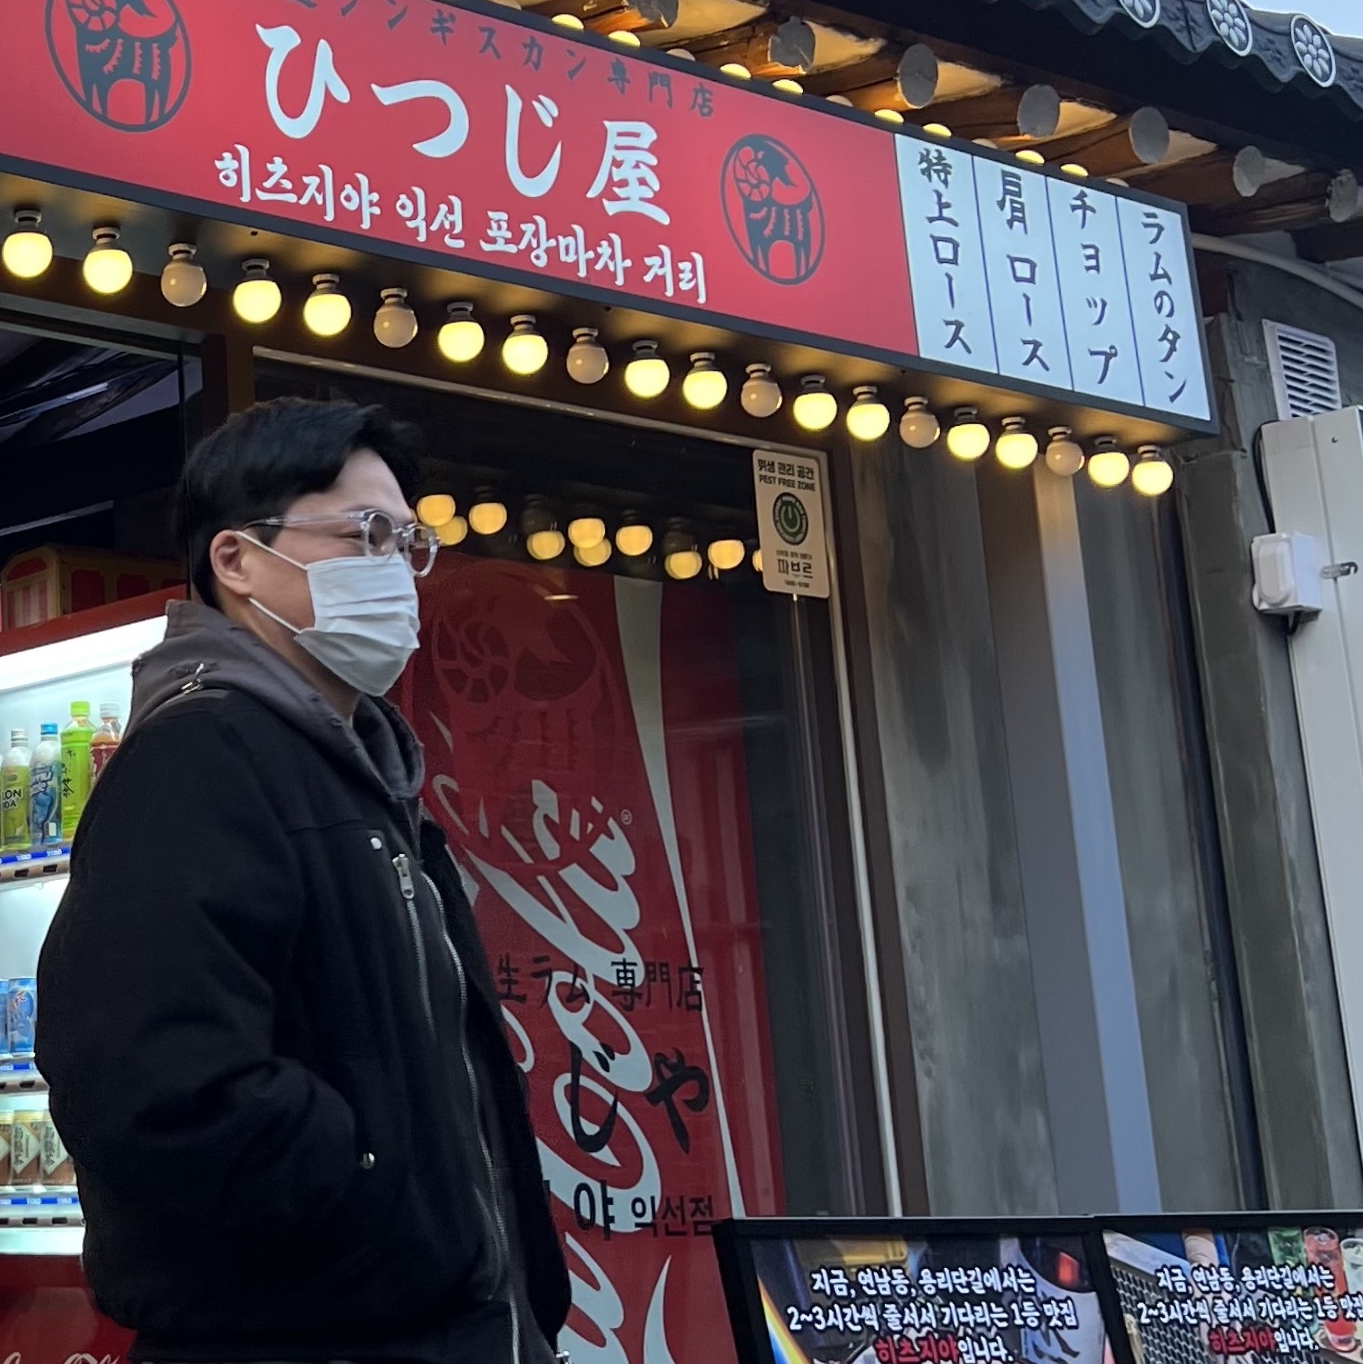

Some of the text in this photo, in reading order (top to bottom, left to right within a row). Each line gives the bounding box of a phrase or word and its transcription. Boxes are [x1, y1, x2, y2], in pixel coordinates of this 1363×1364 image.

[253, 22, 672, 227] ひつじ屋
[215, 144, 708, 305] 히츠지야 익선 포장마차 거리
[917, 148, 973, 355] 特上ロース
[1070, 190, 1120, 384] チョップ
[1141, 211, 1187, 404] ラムのタン
[758, 474, 816, 492] PEST FREE ZONE
[777, 461, 796, 477] 관리
[797, 465, 815, 480] 공간
[811, 1267, 1036, 1297] 지금, 연남동, 용리단길에서는
[1156, 1266, 1335, 1294] 지금, 연남동, 용리단길에서는
[787, 1298, 1078, 1331] 2~3시간씩 줄서서 기다리는 1등 맛집
[1137, 1299, 1212, 1325] 2~3시간씩
[1213, 1297, 1256, 1323] 줄서서
[1259, 1296, 1312, 1321] 기다리는
[1315, 1296, 1338, 1319] 1등
[1208, 1327, 1320, 1354] 히츠지야입니다.
